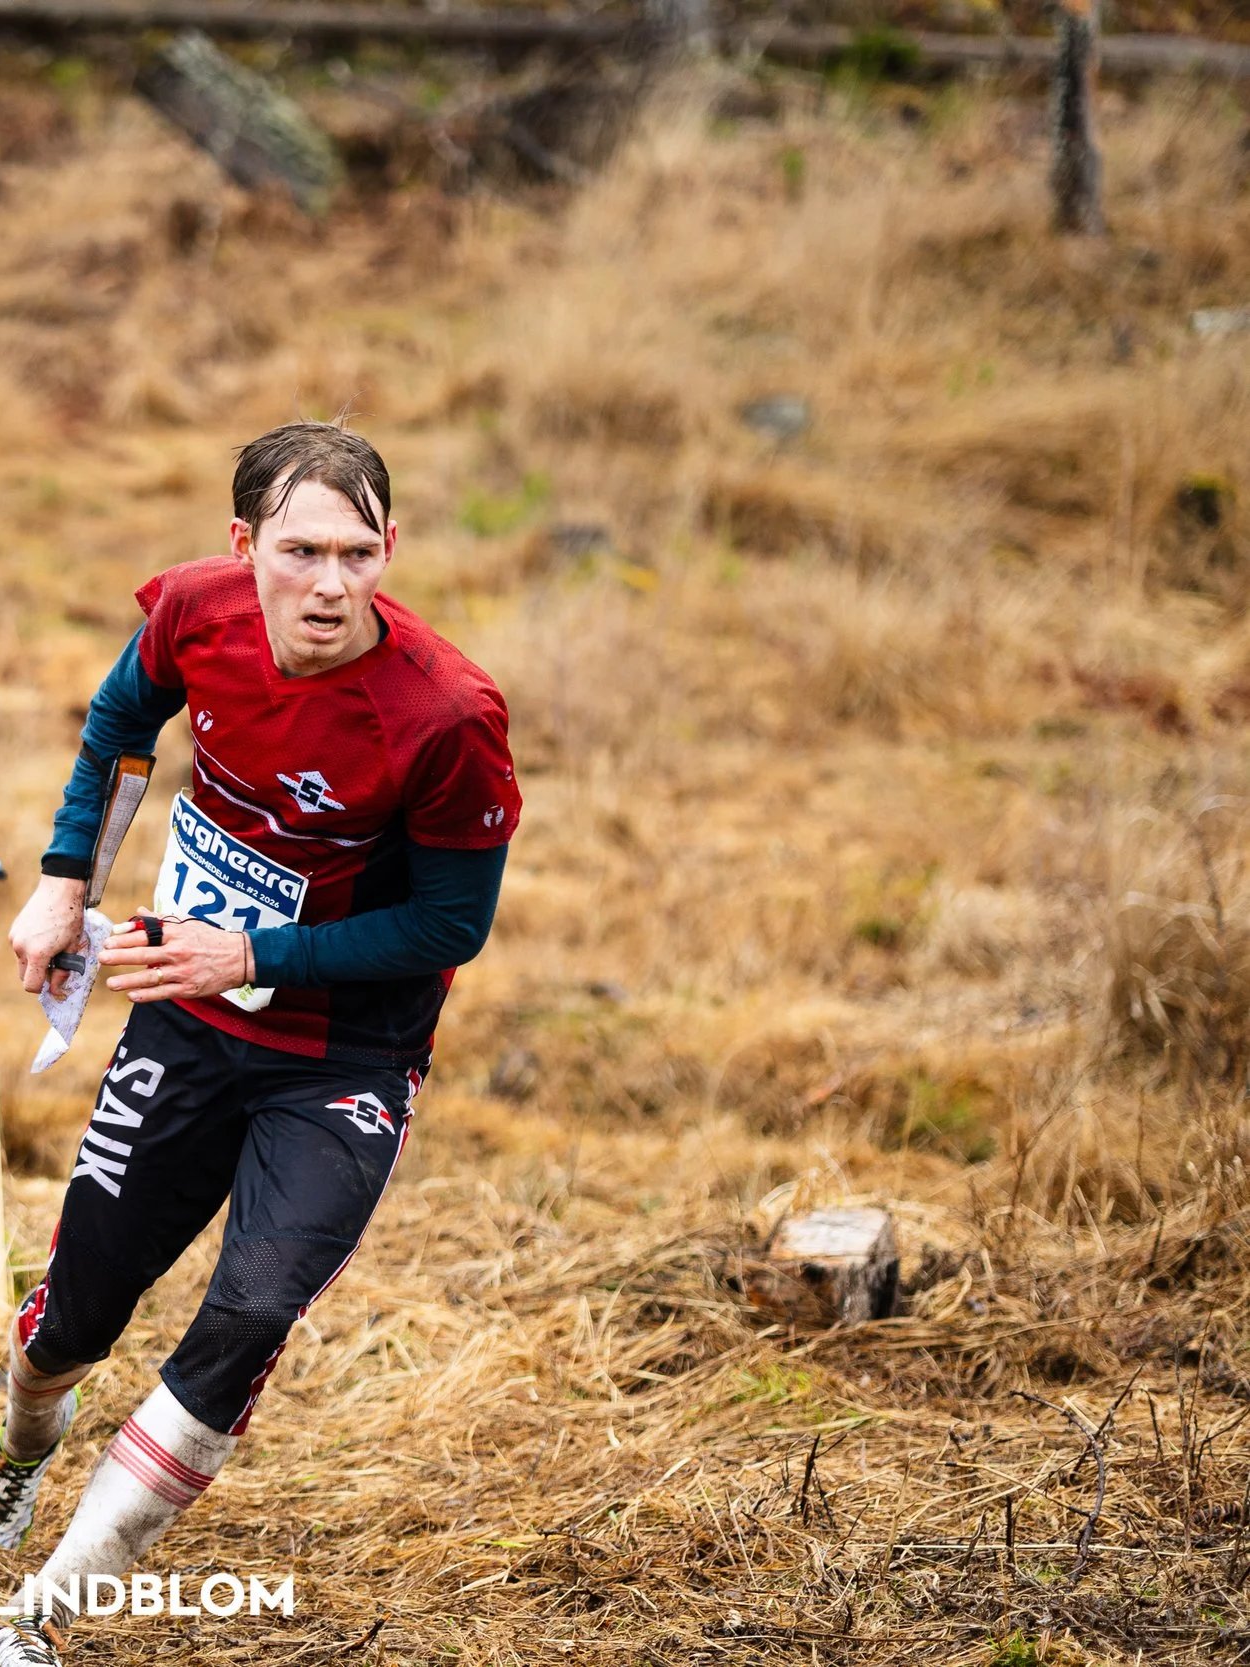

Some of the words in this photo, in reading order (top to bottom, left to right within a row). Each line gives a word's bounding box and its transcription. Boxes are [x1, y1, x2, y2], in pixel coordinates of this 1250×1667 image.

[173, 862, 261, 931] 121
[235, 880, 246, 890] SL
[246, 886, 259, 897] #2
[259, 893, 280, 908] 2026
